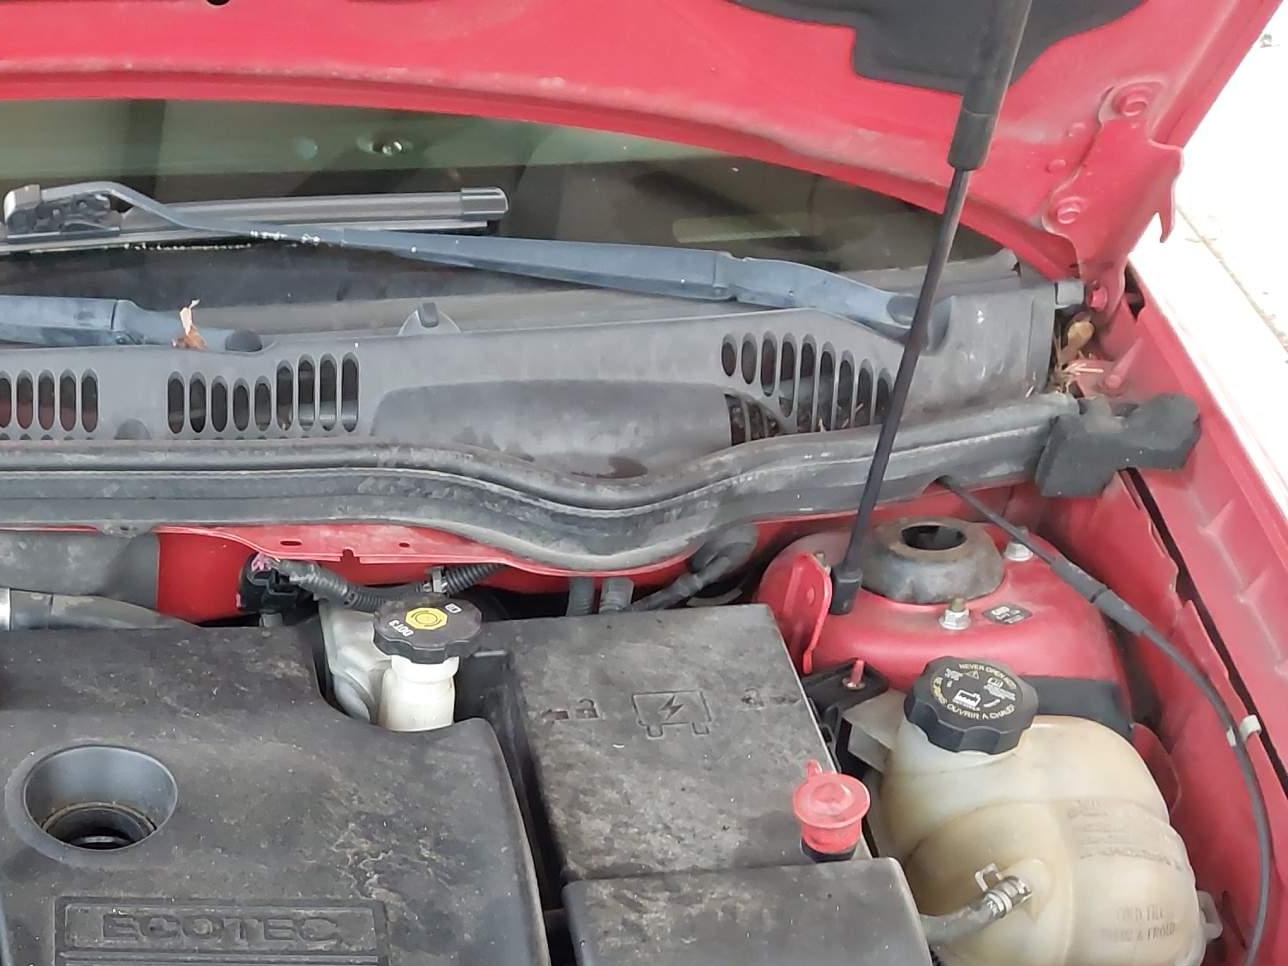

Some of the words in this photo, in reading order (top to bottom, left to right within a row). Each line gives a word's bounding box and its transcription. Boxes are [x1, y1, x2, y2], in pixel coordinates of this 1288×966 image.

[389, 620, 414, 637] DOT3
[958, 663, 985, 672] NEVER
[985, 666, 1005, 679] OPEN
[947, 703, 980, 720] OUVRIR
[102, 914, 339, 945] ECOTEC
